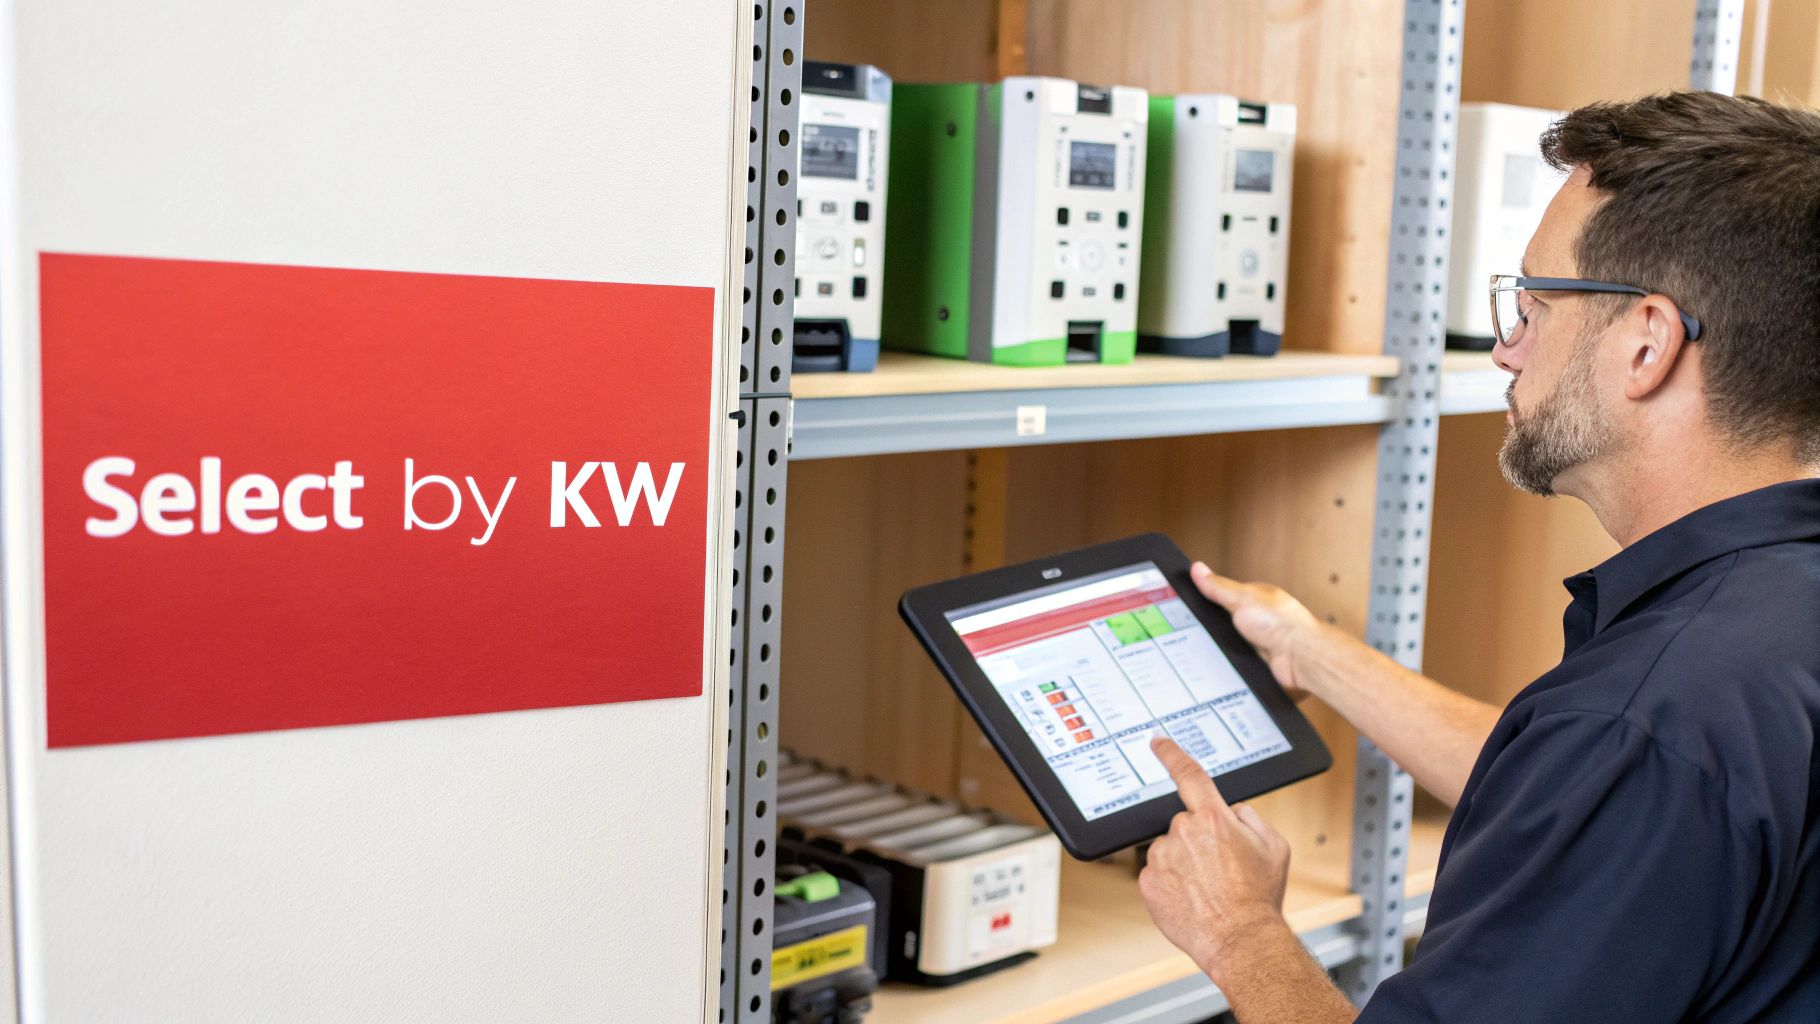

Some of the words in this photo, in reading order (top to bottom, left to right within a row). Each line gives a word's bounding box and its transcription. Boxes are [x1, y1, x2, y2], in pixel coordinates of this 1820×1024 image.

[83, 456, 364, 537] Select
[404, 458, 517, 545] by
[550, 461, 686, 527] KW
